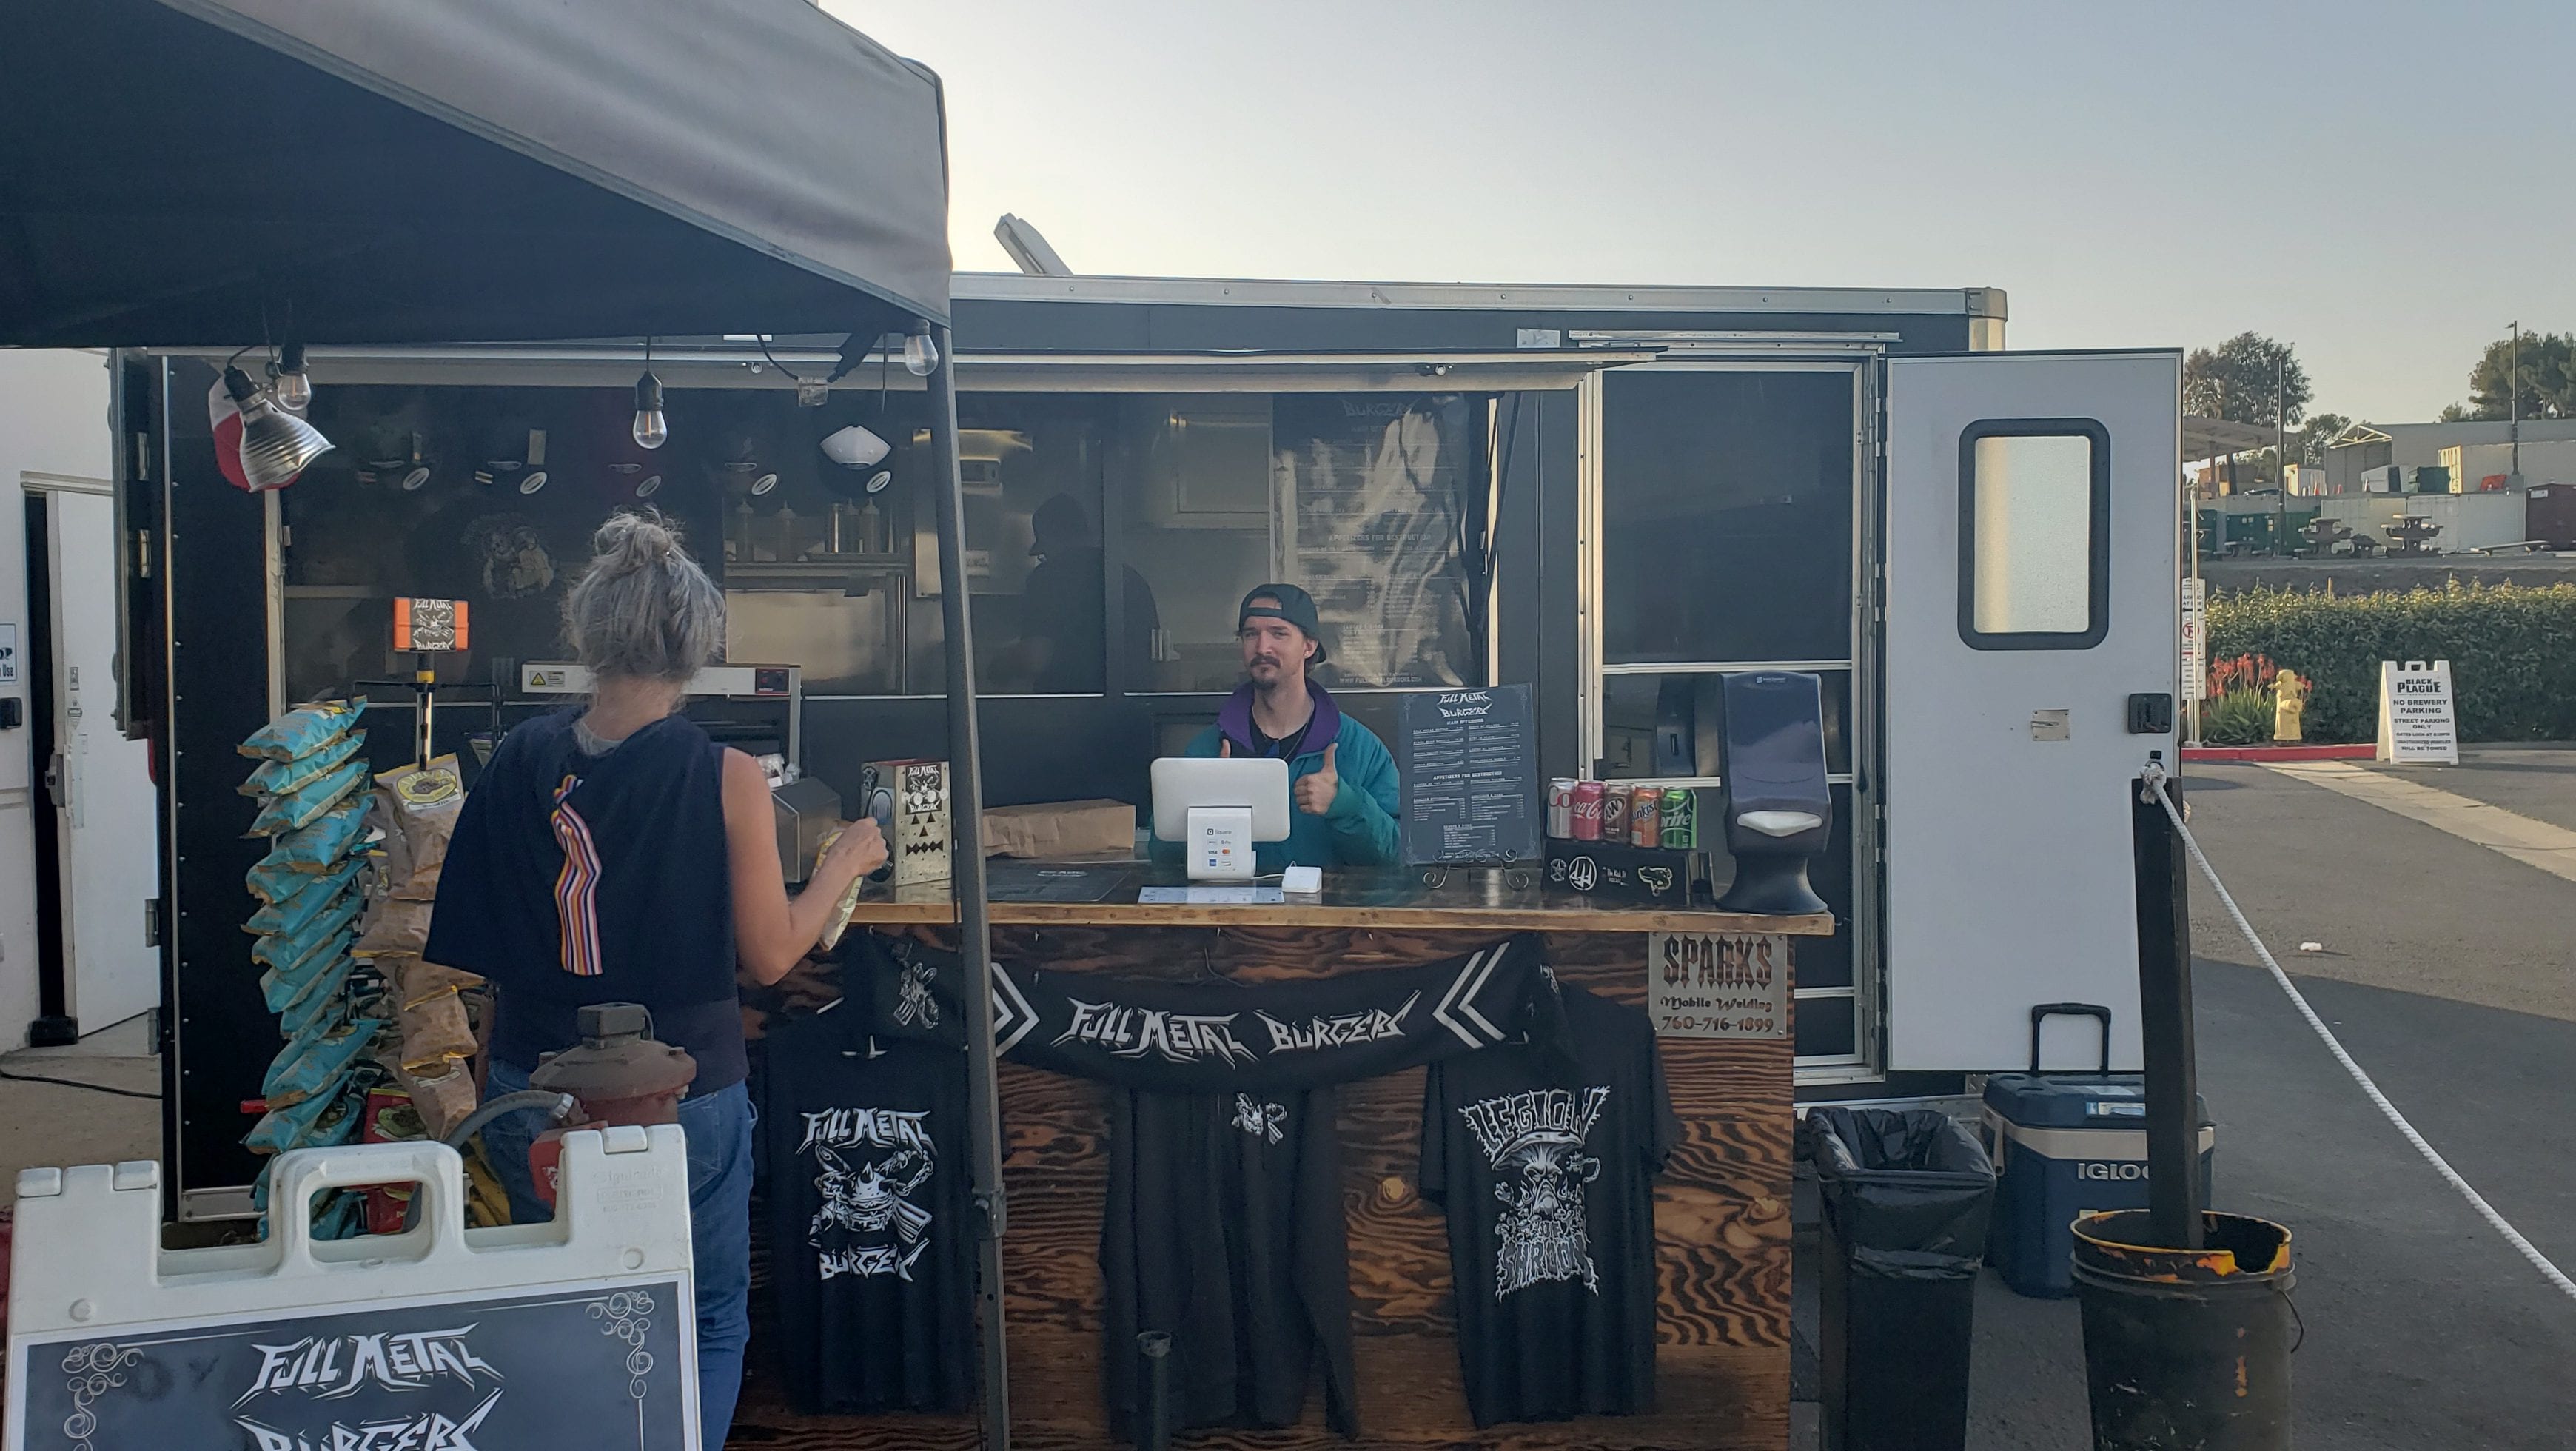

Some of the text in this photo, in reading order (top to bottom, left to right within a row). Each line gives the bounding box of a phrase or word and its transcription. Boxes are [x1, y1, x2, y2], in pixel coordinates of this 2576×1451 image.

[3, 664, 13, 677] Use
[2397, 682, 2442, 693] PLAGUE
[1437, 691, 1494, 705] FULL METAL
[1437, 703, 1493, 717] BURGERS
[1663, 934, 1772, 991] SPARKS
[1660, 996, 1773, 1012] Mobile Welding
[1050, 989, 1423, 1070] FULL METAL BURGERS
[1662, 1016, 1774, 1032] 760-716-1899
[795, 1107, 939, 1156] FULL METAL
[1458, 1085, 1611, 1162] LEGION
[230, 1322, 506, 1410] FULL METAL
